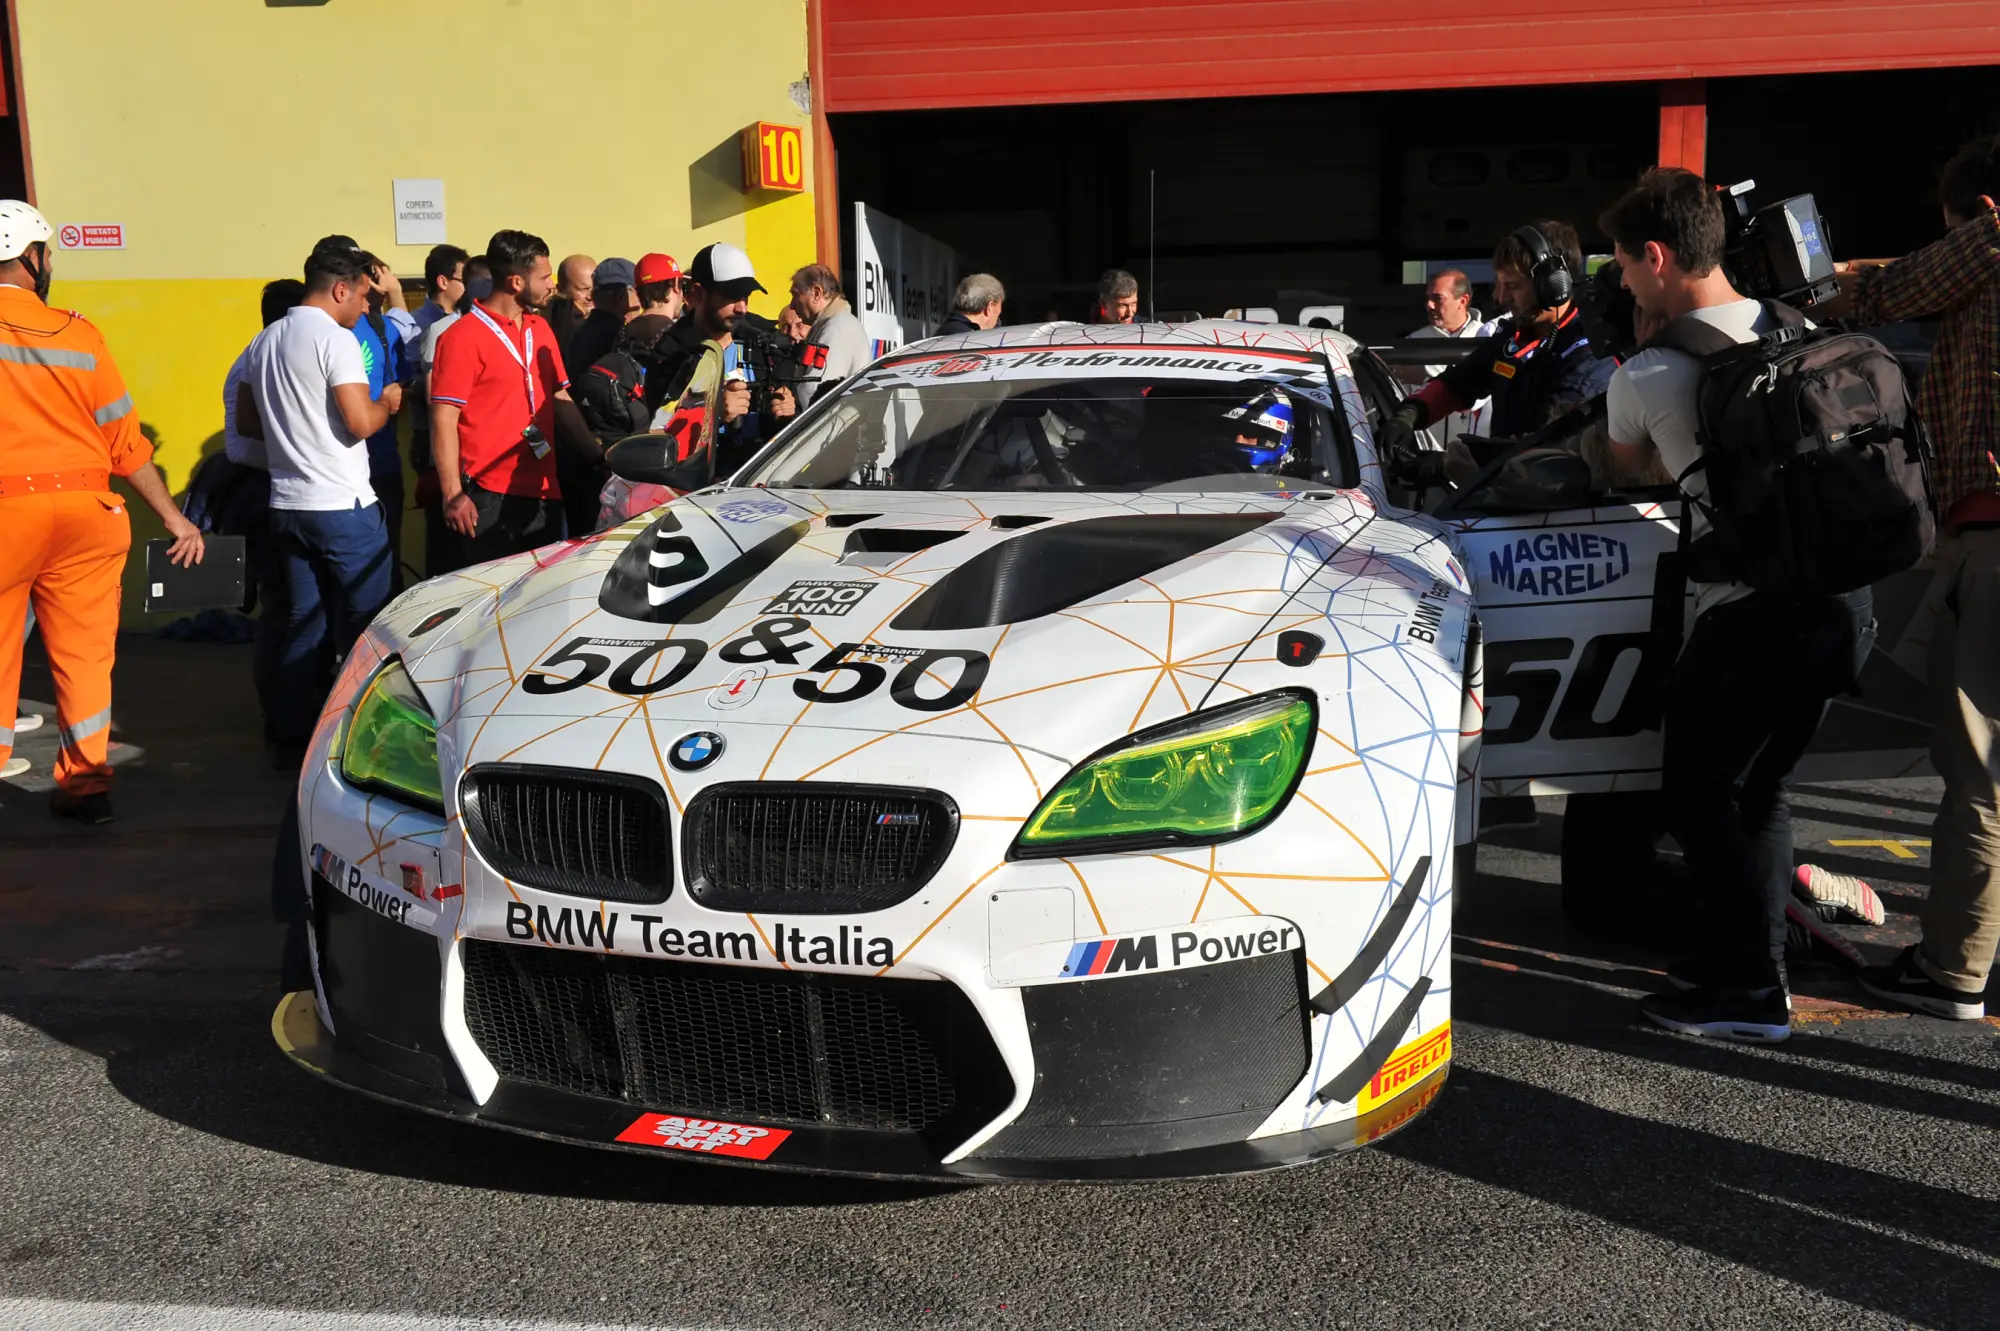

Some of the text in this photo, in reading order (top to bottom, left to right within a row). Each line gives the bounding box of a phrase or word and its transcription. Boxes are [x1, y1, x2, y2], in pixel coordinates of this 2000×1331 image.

[763, 129, 800, 185] 10
[399, 212, 443, 220] ANTINCENDIO
[405, 200, 434, 209] COPERTA
[84, 227, 118, 235] VIETATO
[85, 237, 119, 245] FUMARE
[865, 261, 896, 316] BMW
[902, 273, 926, 321] Team
[1007, 351, 1264, 373] Performance
[787, 587, 864, 602] 100
[832, 581, 873, 589] Group
[764, 602, 851, 615] ANNI
[1407, 600, 1443, 645] BMW
[718, 617, 815, 665] &
[872, 646, 927, 655] Zanardi
[522, 636, 709, 695] 50
[792, 642, 990, 712] 50
[1482, 631, 1657, 746] 50
[348, 866, 412, 924] Power
[505, 901, 895, 968] BMW Team Italia
[1171, 926, 1294, 966] Power
[1371, 1028, 1450, 1100] PIRELLI
[655, 1117, 770, 1138] AUTO
